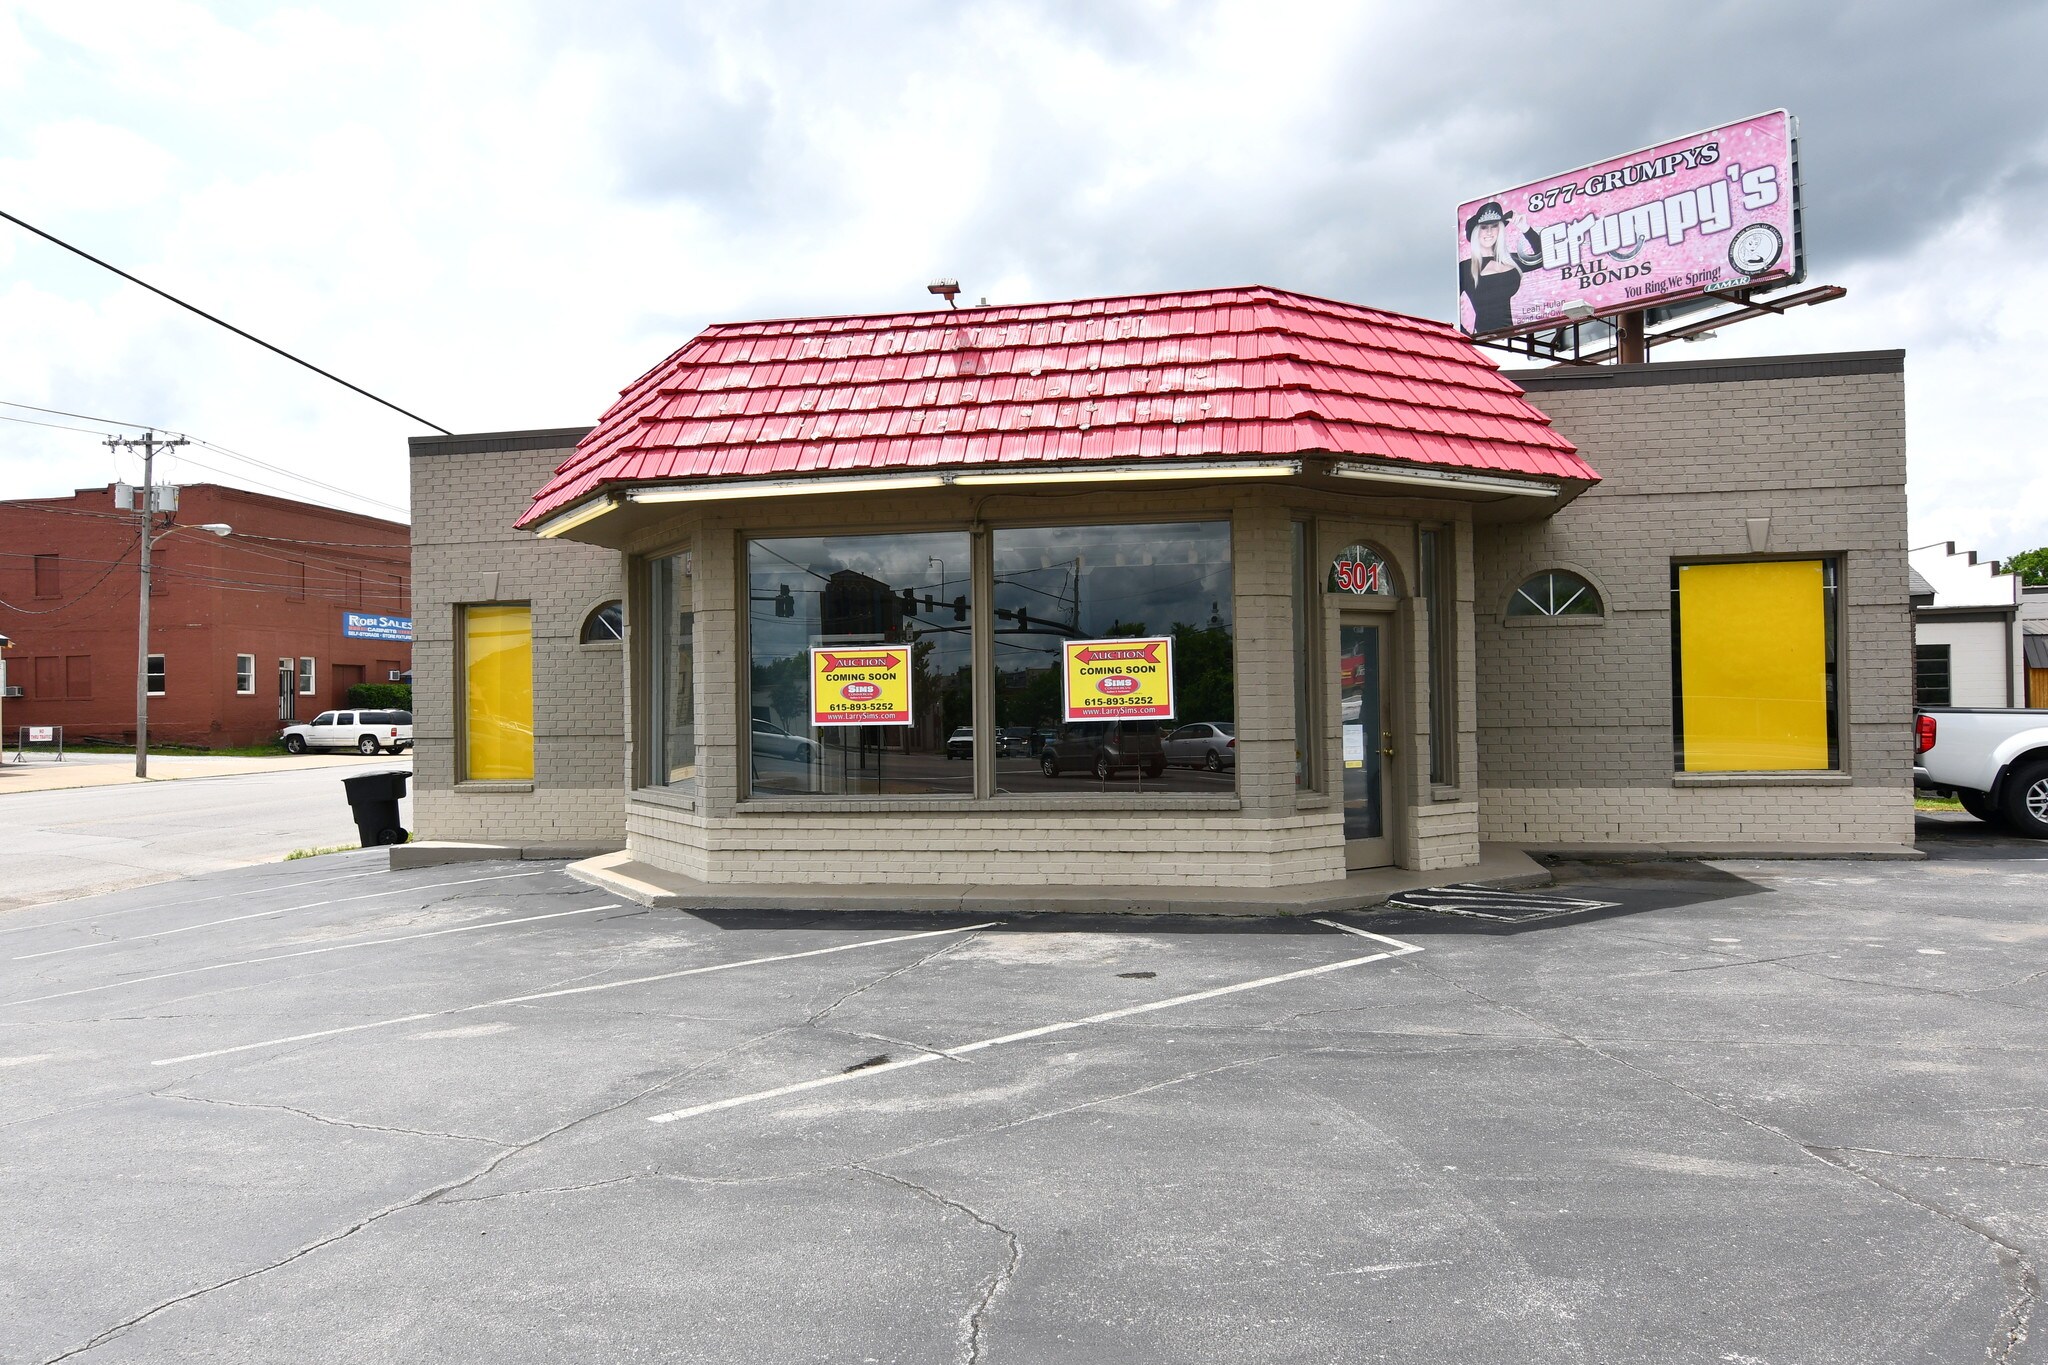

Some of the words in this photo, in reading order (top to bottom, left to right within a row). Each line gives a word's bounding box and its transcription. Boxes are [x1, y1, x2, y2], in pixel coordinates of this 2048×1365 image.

[1528, 142, 1719, 212] 877-GRUMPYS
[1561, 259, 1608, 281] BAIL
[1579, 261, 1652, 289] BONDS
[1625, 286, 1642, 299] You
[1686, 266, 1721, 286] Spring!
[1707, 277, 1748, 290] LAMAR
[1522, 304, 1541, 315] Leah
[1338, 560, 1379, 592] 501
[348, 614, 378, 626] ROBI
[379, 617, 413, 630] SALES
[1090, 650, 1145, 660] AUCTION
[835, 658, 887, 667] AUCTION
[1080, 666, 1122, 675] COMING
[1126, 665, 1156, 674] SOON
[826, 673, 866, 681] COMING
[868, 672, 897, 681] SOON
[1104, 678, 1132, 687] SIMS
[848, 685, 874, 693] SIMS
[1084, 696, 1153, 706] 615-893-5252
[829, 702, 894, 711] 615-893-5252
[1082, 706, 1156, 717] www.LarrySims.com
[827, 712, 896, 722] www.LarrySims.com
